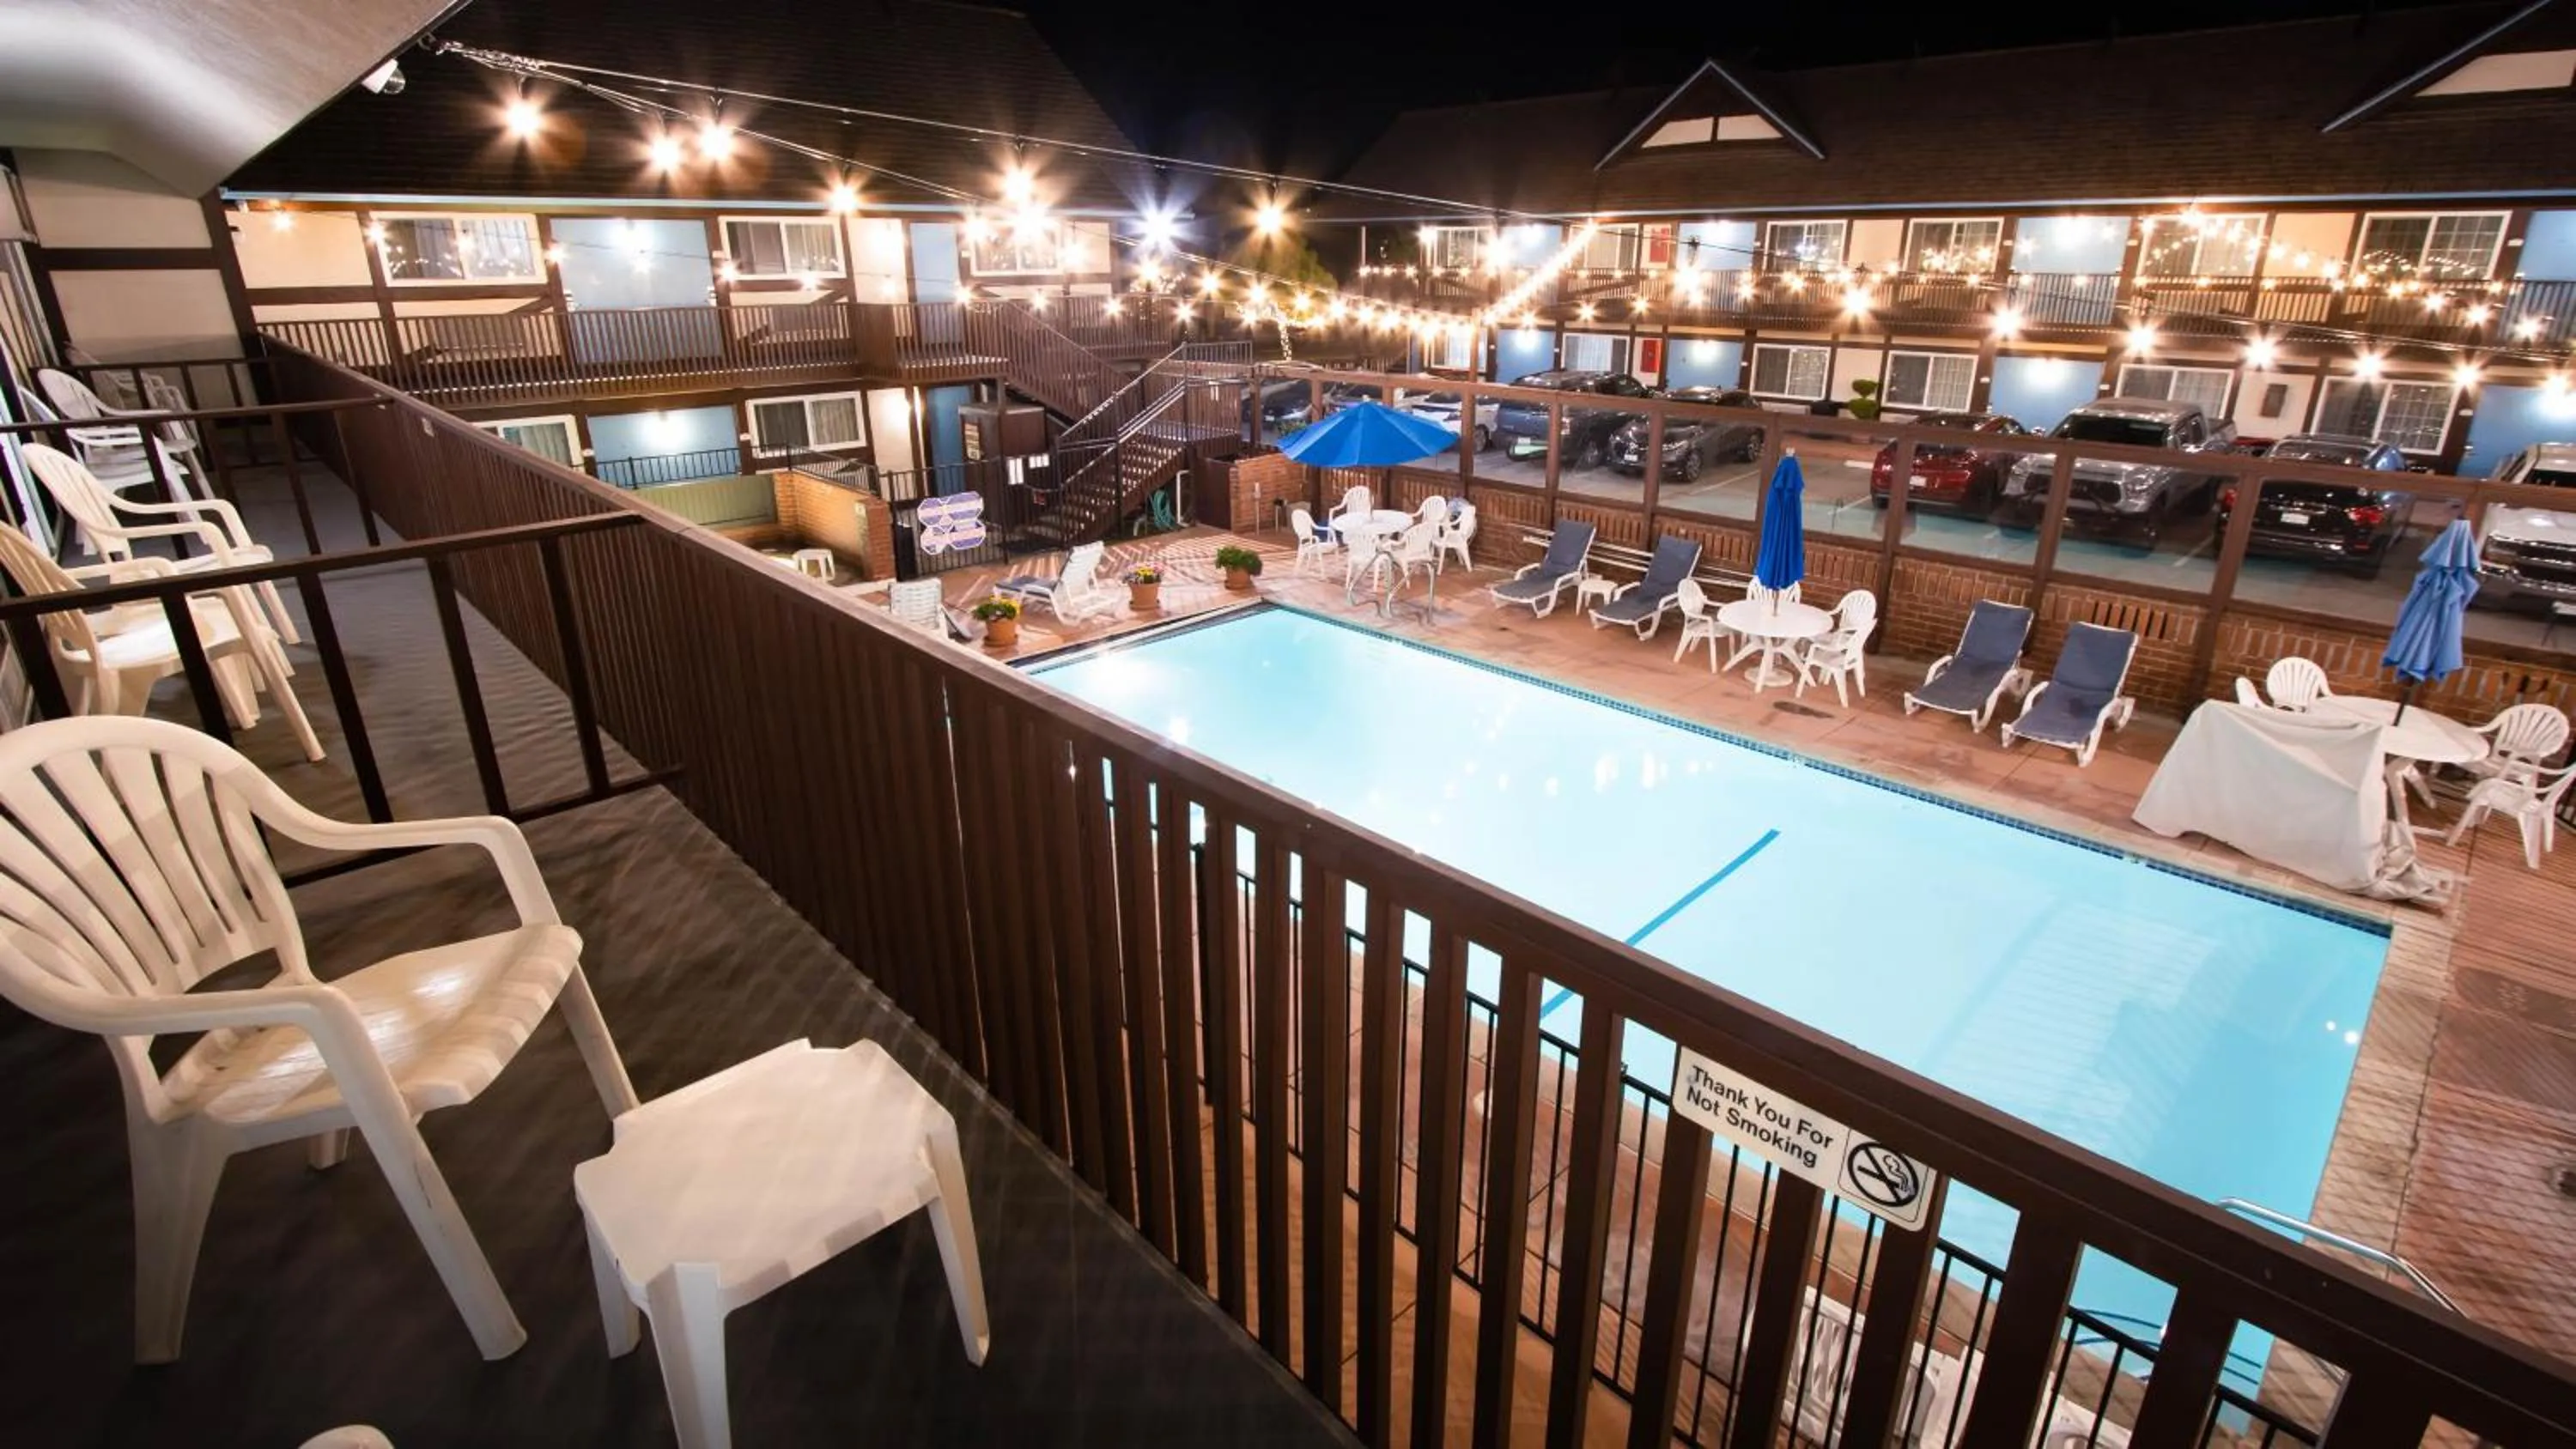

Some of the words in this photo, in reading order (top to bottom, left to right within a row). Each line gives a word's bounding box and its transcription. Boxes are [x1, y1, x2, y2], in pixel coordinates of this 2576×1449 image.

[1686, 1086, 1720, 1117] Not
[1726, 1107, 1818, 1168] Smoking
[1692, 1064, 1749, 1109] Thank
[1754, 1096, 1790, 1130] You
[1796, 1119, 1833, 1149] For
